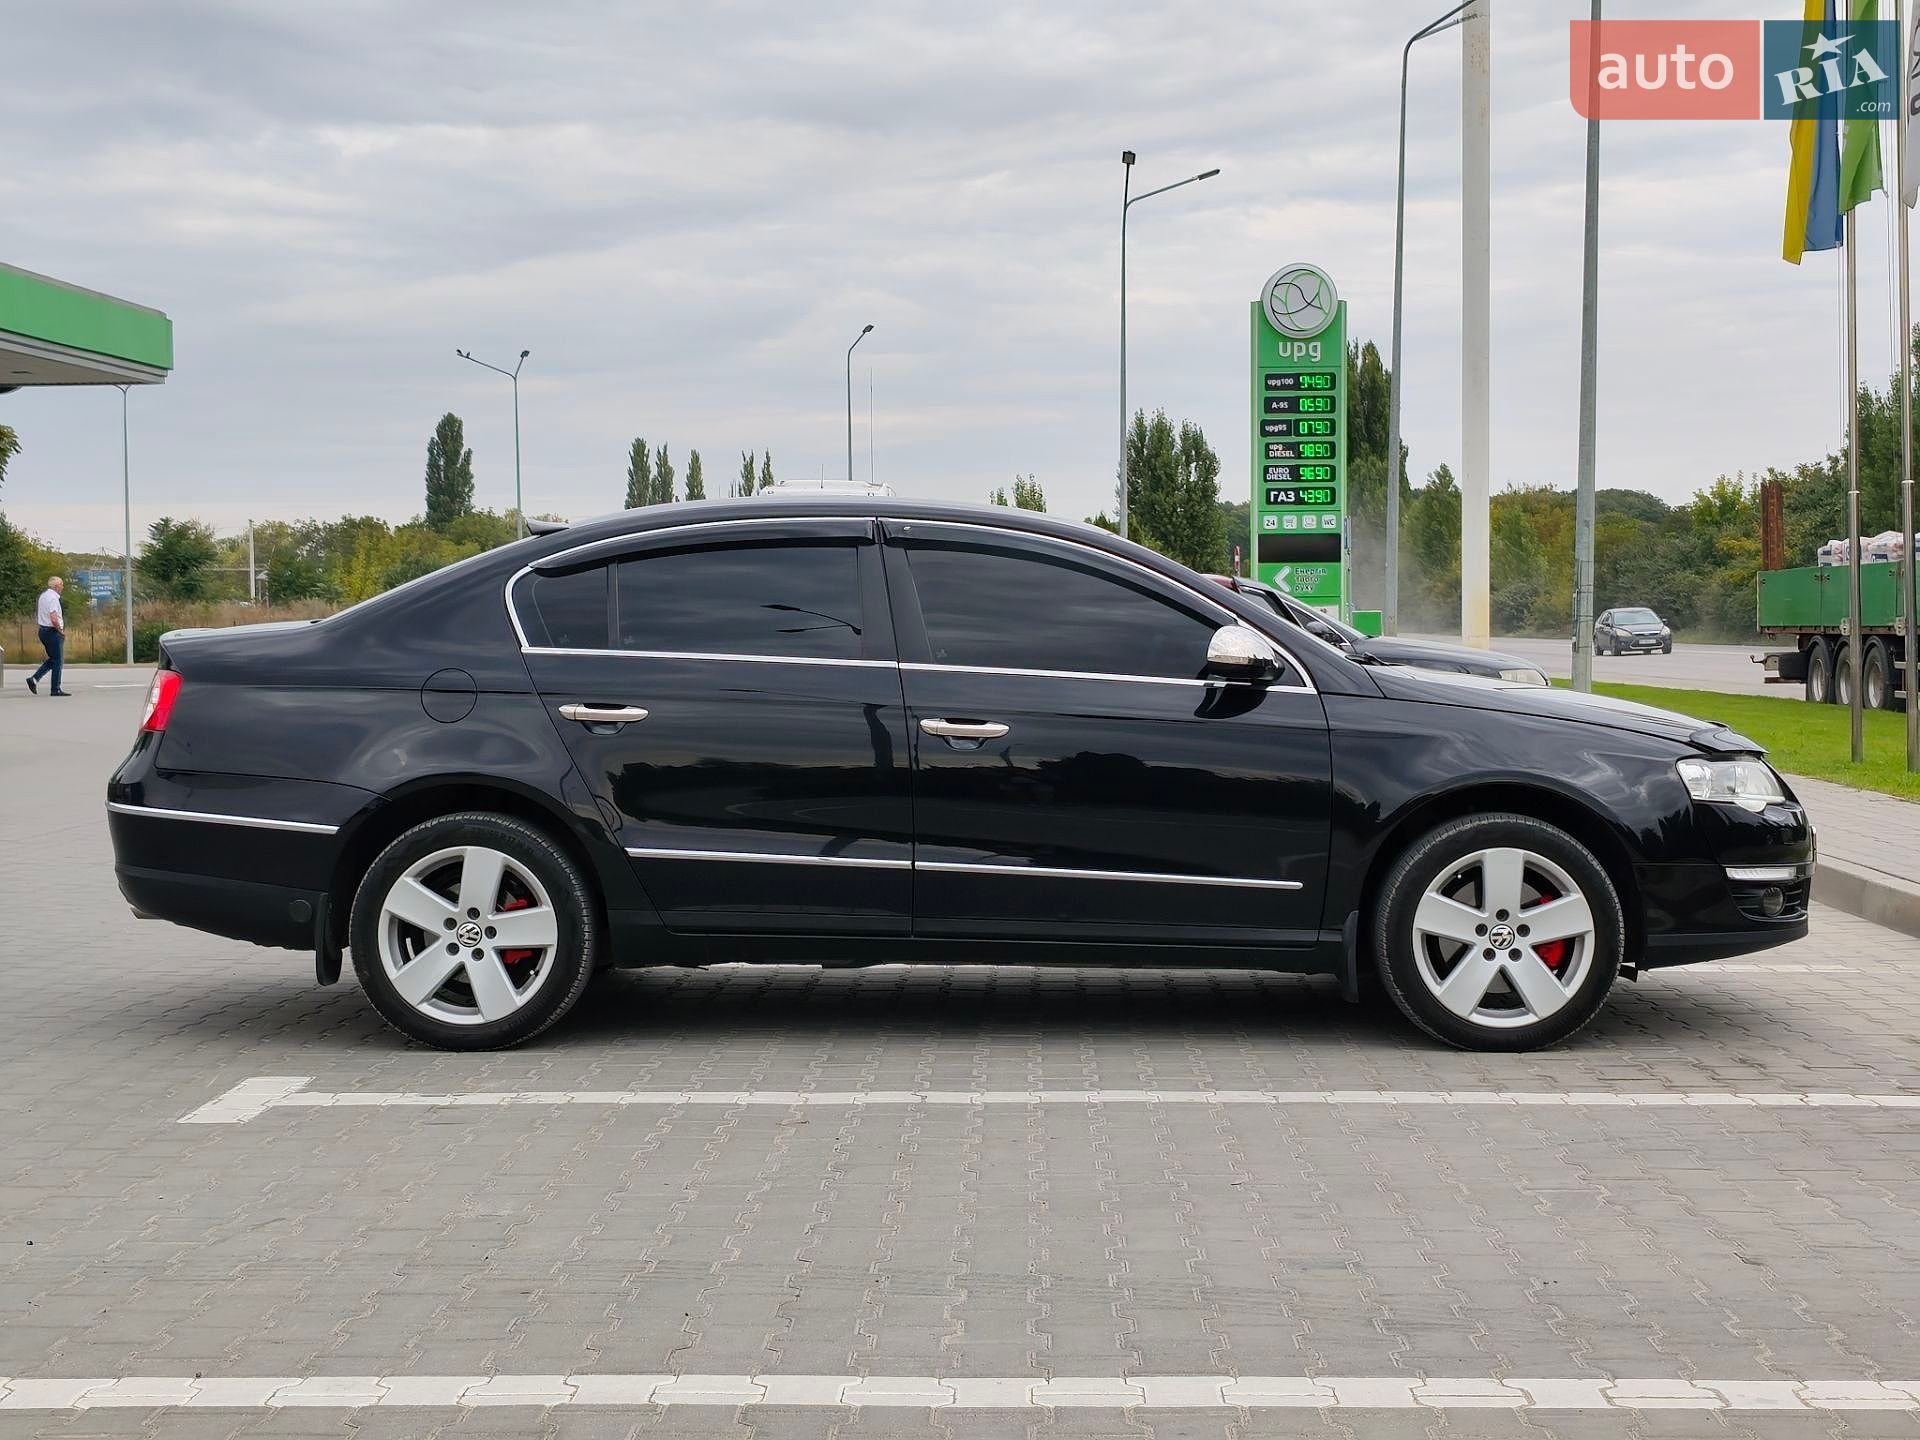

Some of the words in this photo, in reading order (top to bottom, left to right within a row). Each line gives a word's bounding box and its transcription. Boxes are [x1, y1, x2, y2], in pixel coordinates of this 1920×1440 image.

[1278, 341, 1321, 362] upg
[1266, 473, 1292, 481] DIESEL
[1270, 491, 1295, 502] ГАЗ
[1265, 519, 1276, 527] 24
[1323, 518, 1335, 526] WC
